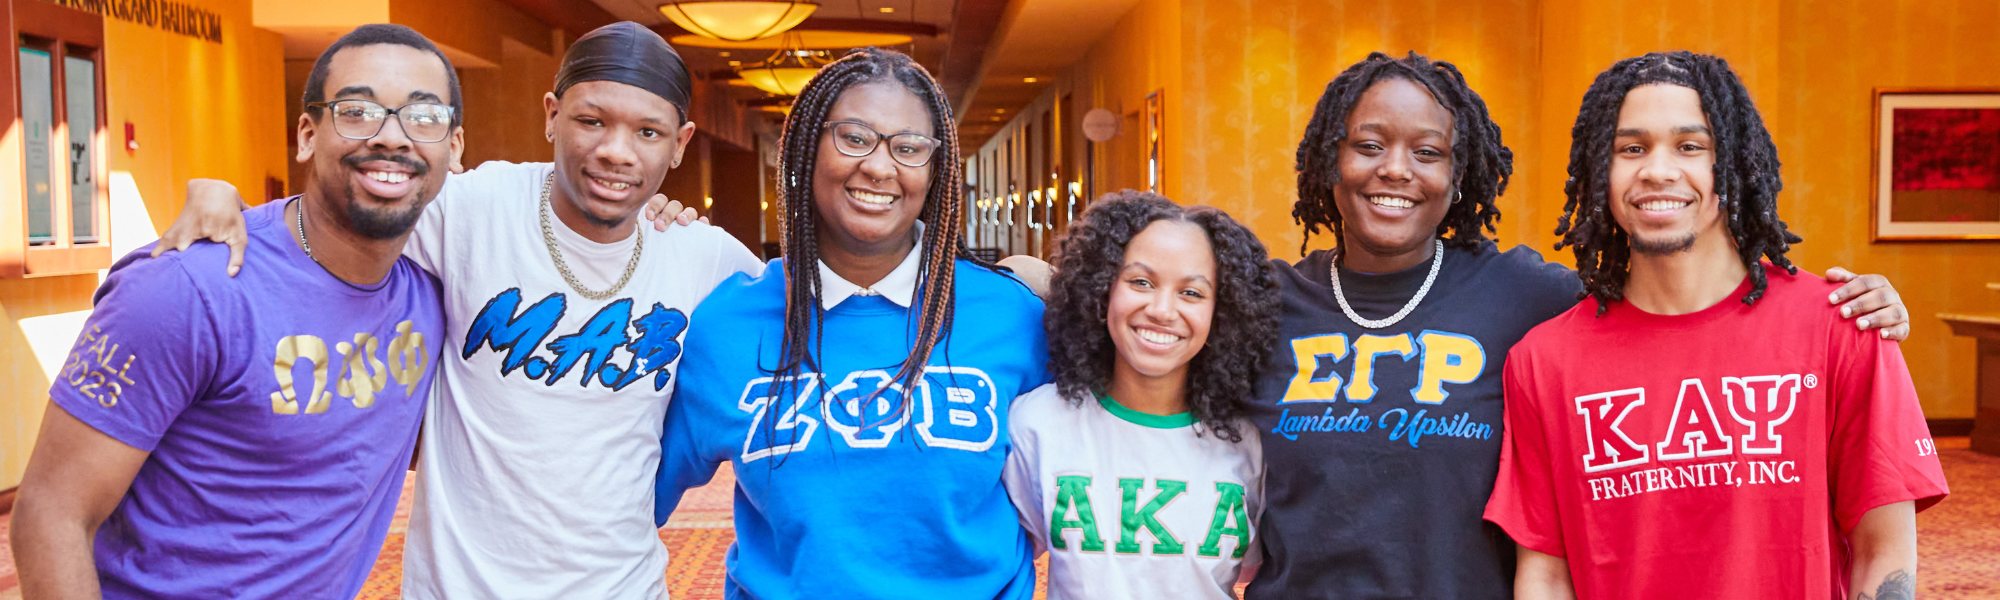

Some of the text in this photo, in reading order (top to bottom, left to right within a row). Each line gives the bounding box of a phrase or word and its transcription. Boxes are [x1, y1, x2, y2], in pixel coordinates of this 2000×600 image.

[161, 0, 222, 44] BALLROOM
[80, 323, 136, 386] FALL
[462, 287, 689, 392] M.A.B.
[61, 352, 122, 408] 2023
[1271, 406, 1493, 448] Lambda Upsilon
[1588, 461, 1801, 501] FRATERNITY, INC.
